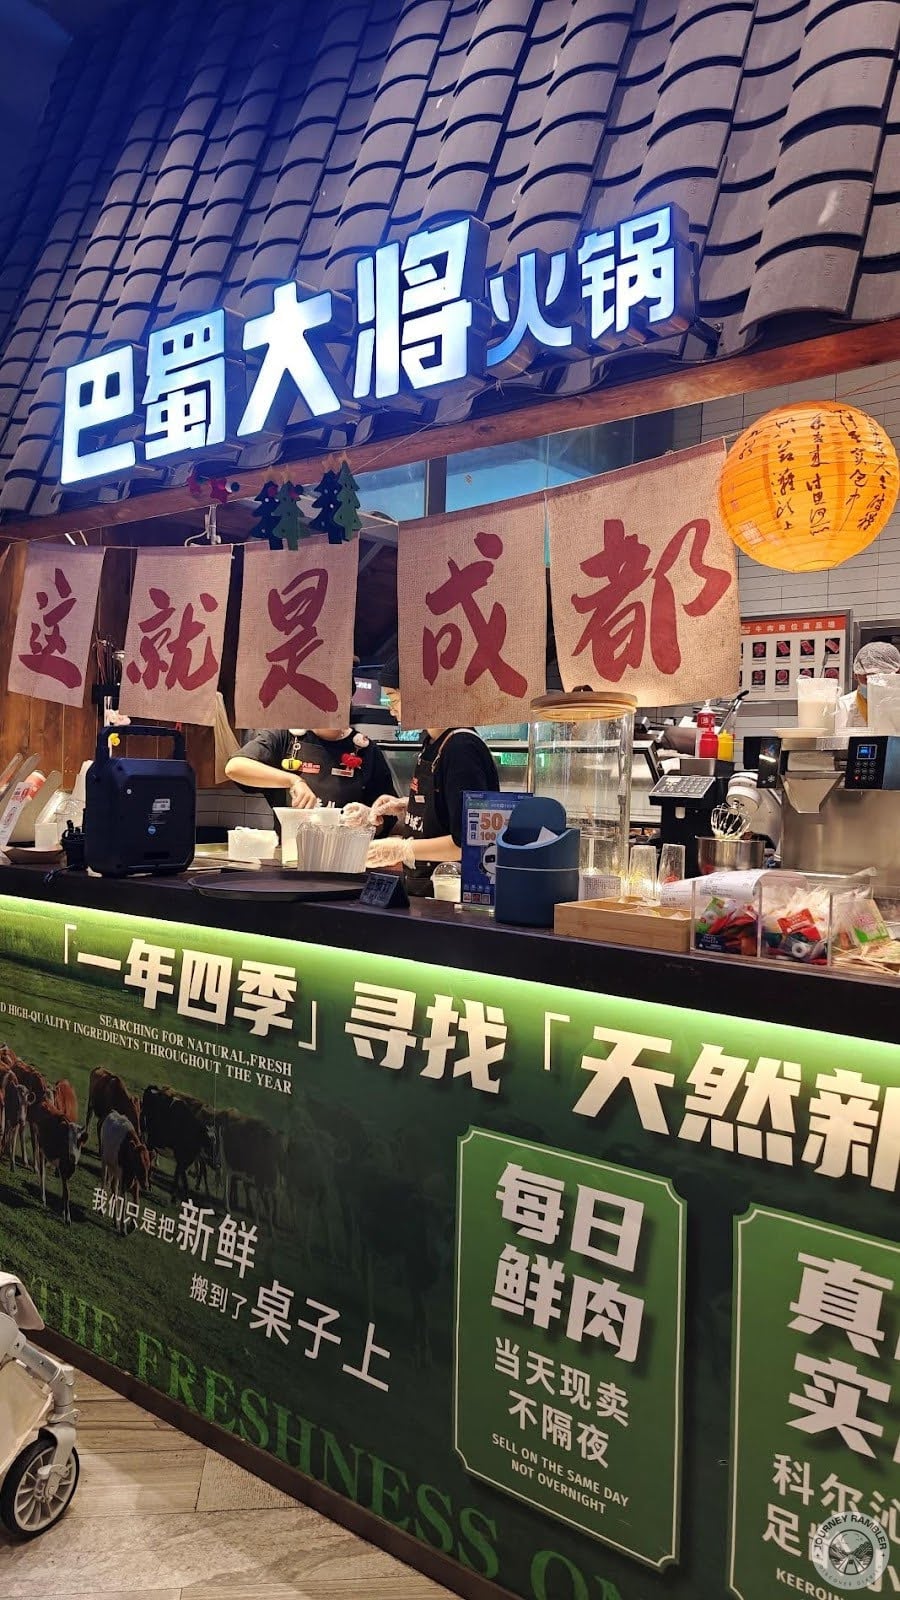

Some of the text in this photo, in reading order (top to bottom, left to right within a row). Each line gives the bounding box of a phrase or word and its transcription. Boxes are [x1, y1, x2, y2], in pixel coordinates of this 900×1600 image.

[61, 206, 675, 484] 巴蜀大将火锅
[480, 812, 509, 831] 50
[8, 1004, 71, 1031] HIGH-QUALITY
[73, 1022, 140, 1050] INGREDIENTS
[143, 1041, 221, 1074] THROUGHOUT
[226, 1064, 251, 1082] THE
[256, 1072, 292, 1094] YEAR
[100, 1014, 159, 1040] SEARCHING
[162, 1030, 184, 1047] FOR
[92, 1187, 259, 1279] 我们只是把新鲜
[495, 1161, 645, 1272] 每日
[190, 1272, 391, 1393] 搬到了桌子上
[491, 1242, 645, 1363] 鲜肉
[787, 1252, 900, 1360] 真
[494, 1336, 630, 1428] 当天现卖
[786, 1352, 900, 1460] 实
[136, 1328, 499, 1579] FRESHNESS
[492, 1433, 629, 1507] SELL ON THE SAME DAY
[508, 1389, 609, 1469] 不隔夜
[511, 1459, 606, 1514] NOT OVERNIGHT
